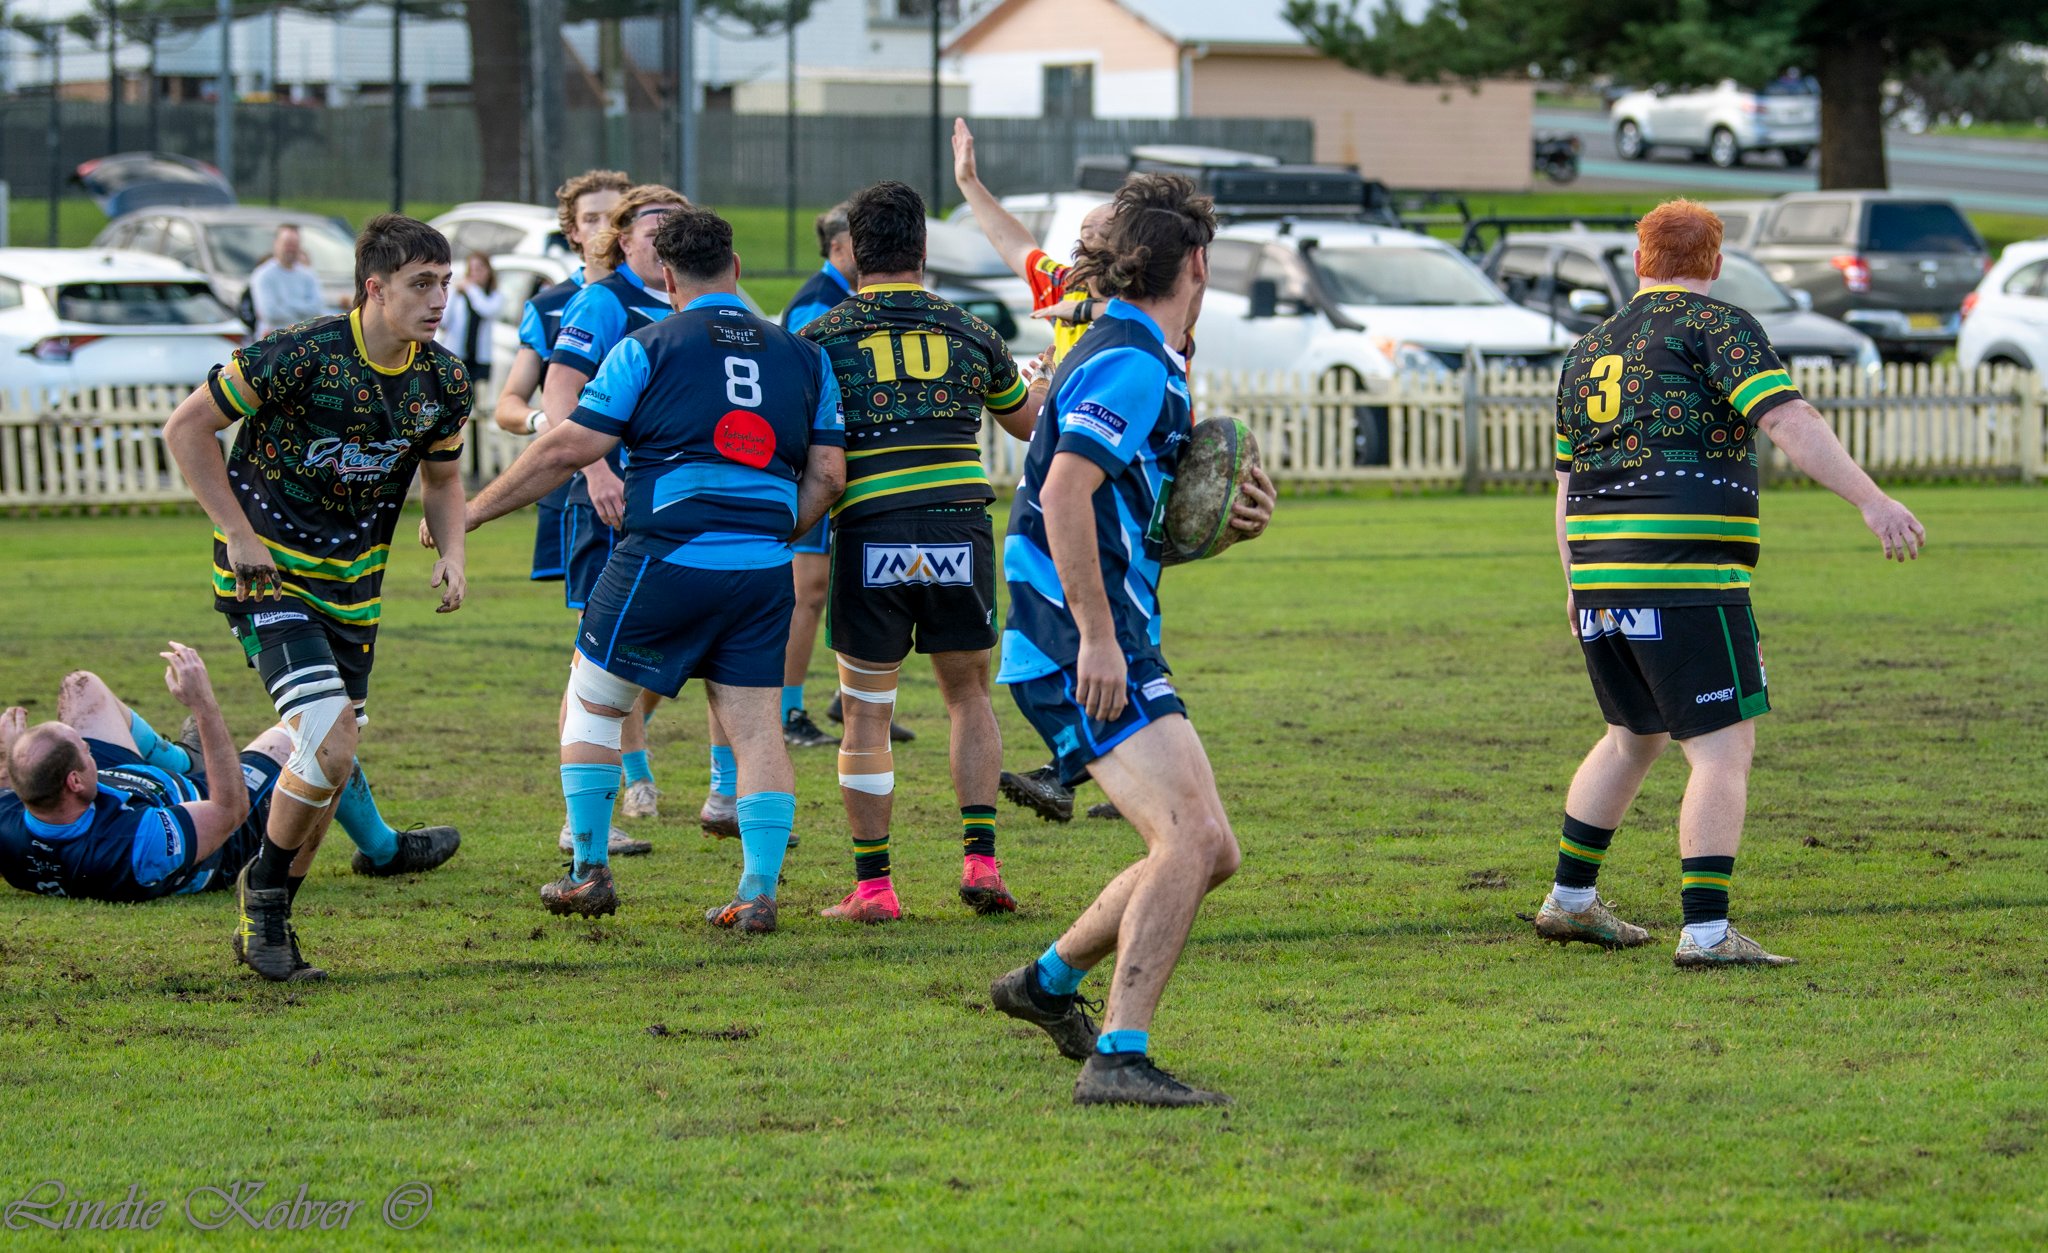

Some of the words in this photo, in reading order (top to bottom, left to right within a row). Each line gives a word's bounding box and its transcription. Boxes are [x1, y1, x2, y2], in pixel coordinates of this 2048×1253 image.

[725, 334, 750, 342] HOTEL
[857, 330, 950, 383] 10
[724, 355, 763, 408] 8
[1586, 354, 1624, 423] 3
[1696, 687, 1735, 704] GOOSEY
